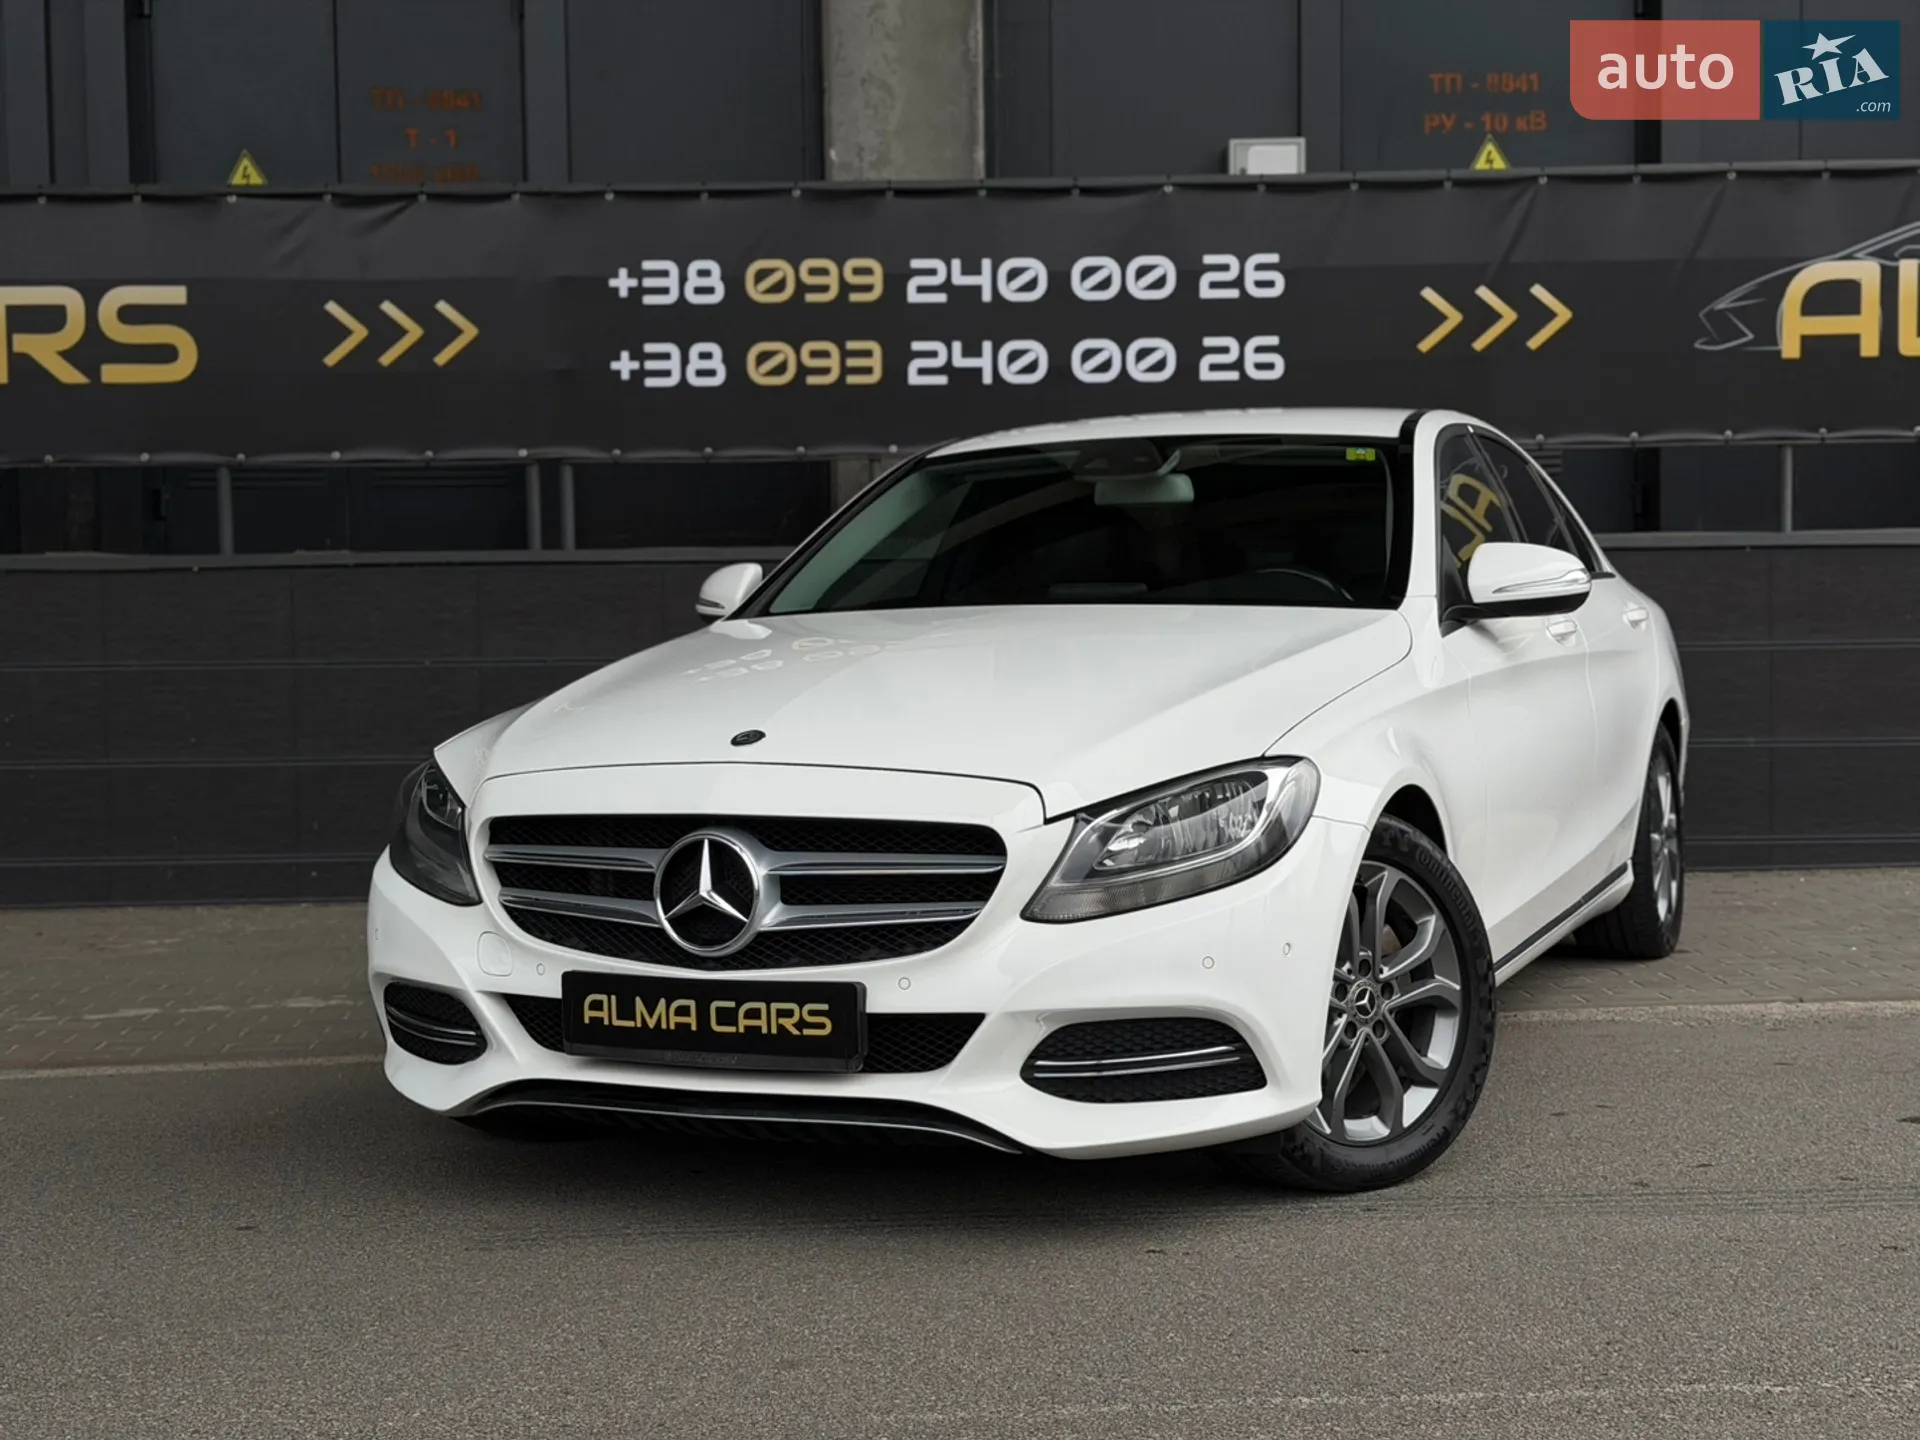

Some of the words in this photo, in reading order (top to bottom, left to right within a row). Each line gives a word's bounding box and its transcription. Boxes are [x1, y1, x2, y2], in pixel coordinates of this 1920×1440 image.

[1480, 110, 1509, 134] 10
[608, 259, 725, 305] +38
[745, 257, 884, 304] 099
[906, 256, 1048, 303] 240
[1070, 254, 1177, 301] 00
[1199, 252, 1286, 299] 26
[0, 284, 199, 384] RS
[610, 342, 726, 387] +38
[746, 340, 883, 386] 093
[907, 339, 1049, 386] 240
[1070, 337, 1177, 384] 00
[1199, 335, 1286, 381] 26
[584, 993, 697, 1031] ALMA
[709, 1000, 832, 1036] CARS
